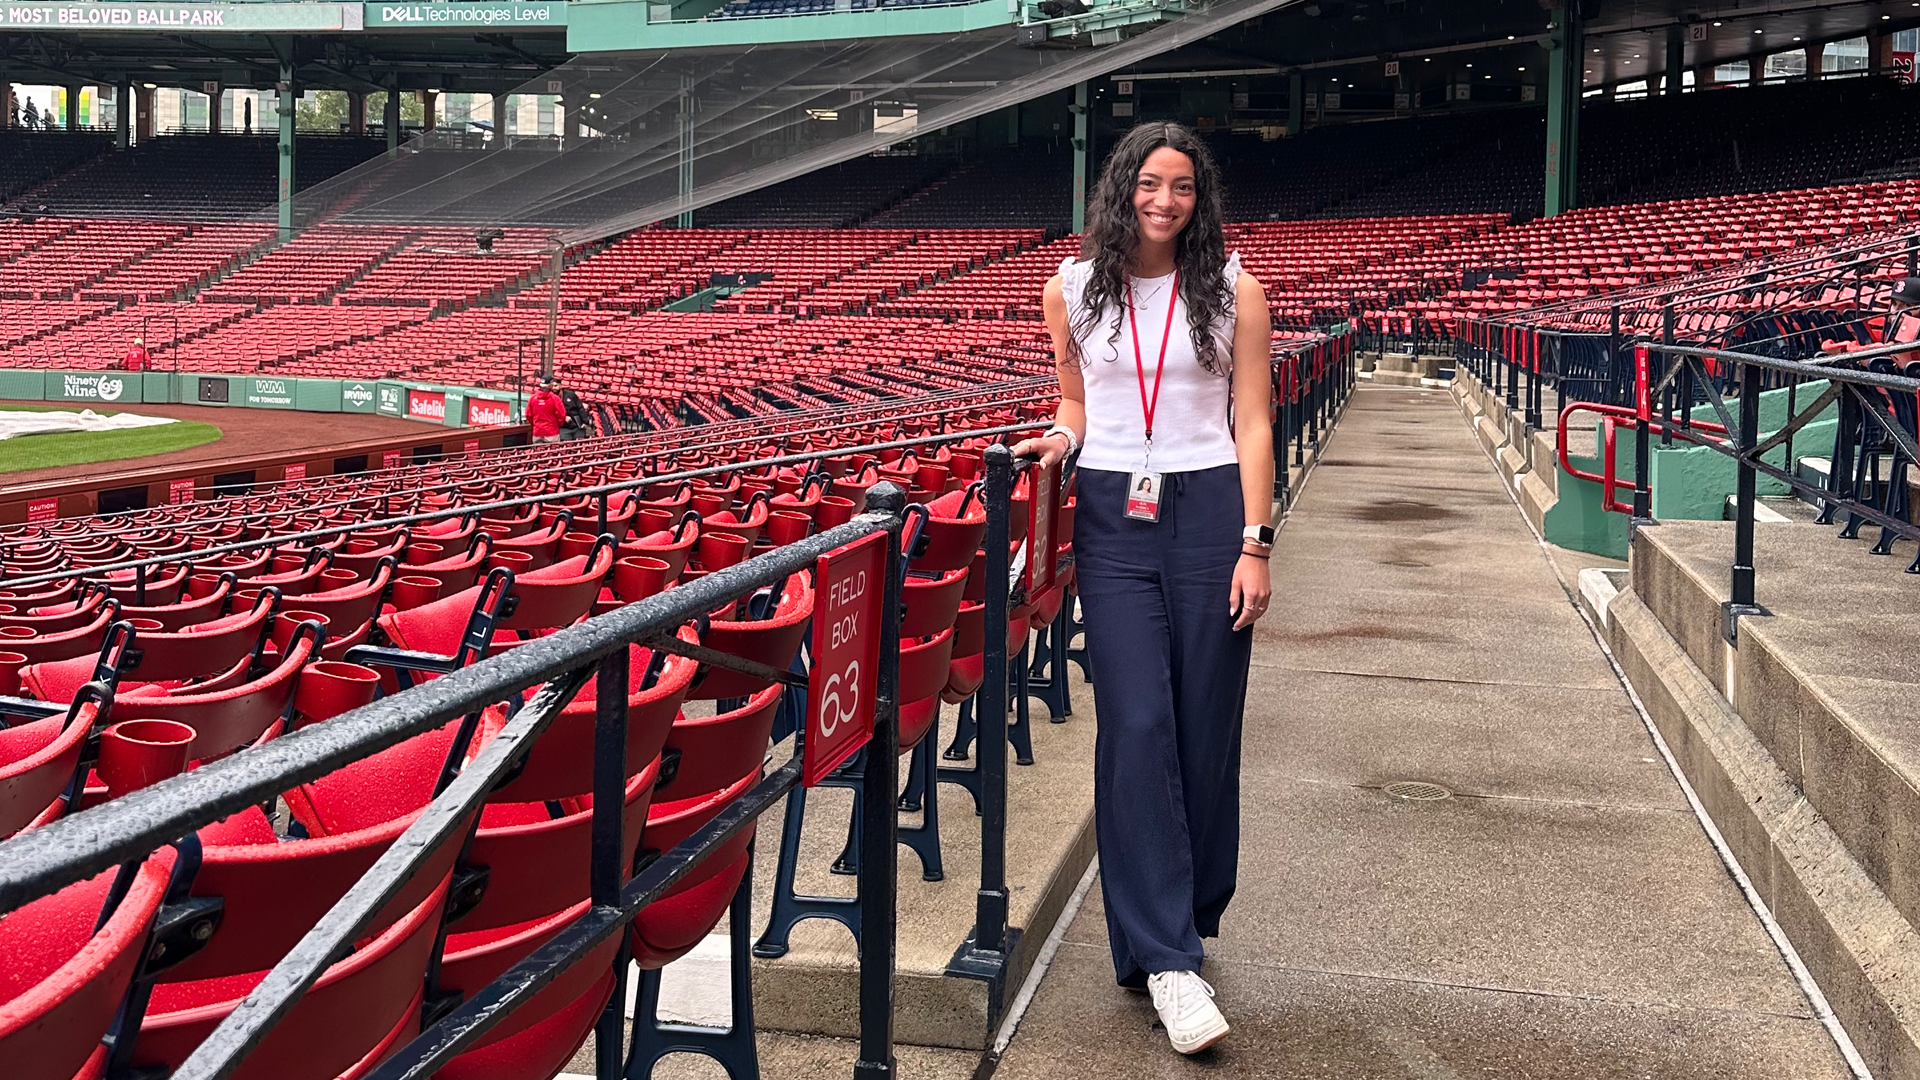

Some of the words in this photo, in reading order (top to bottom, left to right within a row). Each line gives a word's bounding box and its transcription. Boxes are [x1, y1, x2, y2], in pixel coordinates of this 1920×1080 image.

[9, 8, 53, 23] MOST
[58, 9, 132, 24] BELOVED
[137, 9, 225, 26] BALLPARK
[514, 6, 550, 21] Level
[1693, 27, 1703, 39] 21
[1386, 64, 1397, 75] 20
[206, 83, 215, 92] 16
[551, 82, 559, 91] 17
[1121, 83, 1130, 92] 19
[64, 375, 99, 386] Ninety
[64, 385, 98, 397] Nine
[344, 389, 373, 401] IRVING
[29, 503, 57, 512] CAUTION!
[1032, 534, 1048, 580] 62
[828, 570, 866, 612] FIELD
[831, 610, 859, 650] BOX
[820, 660, 860, 738] 63
